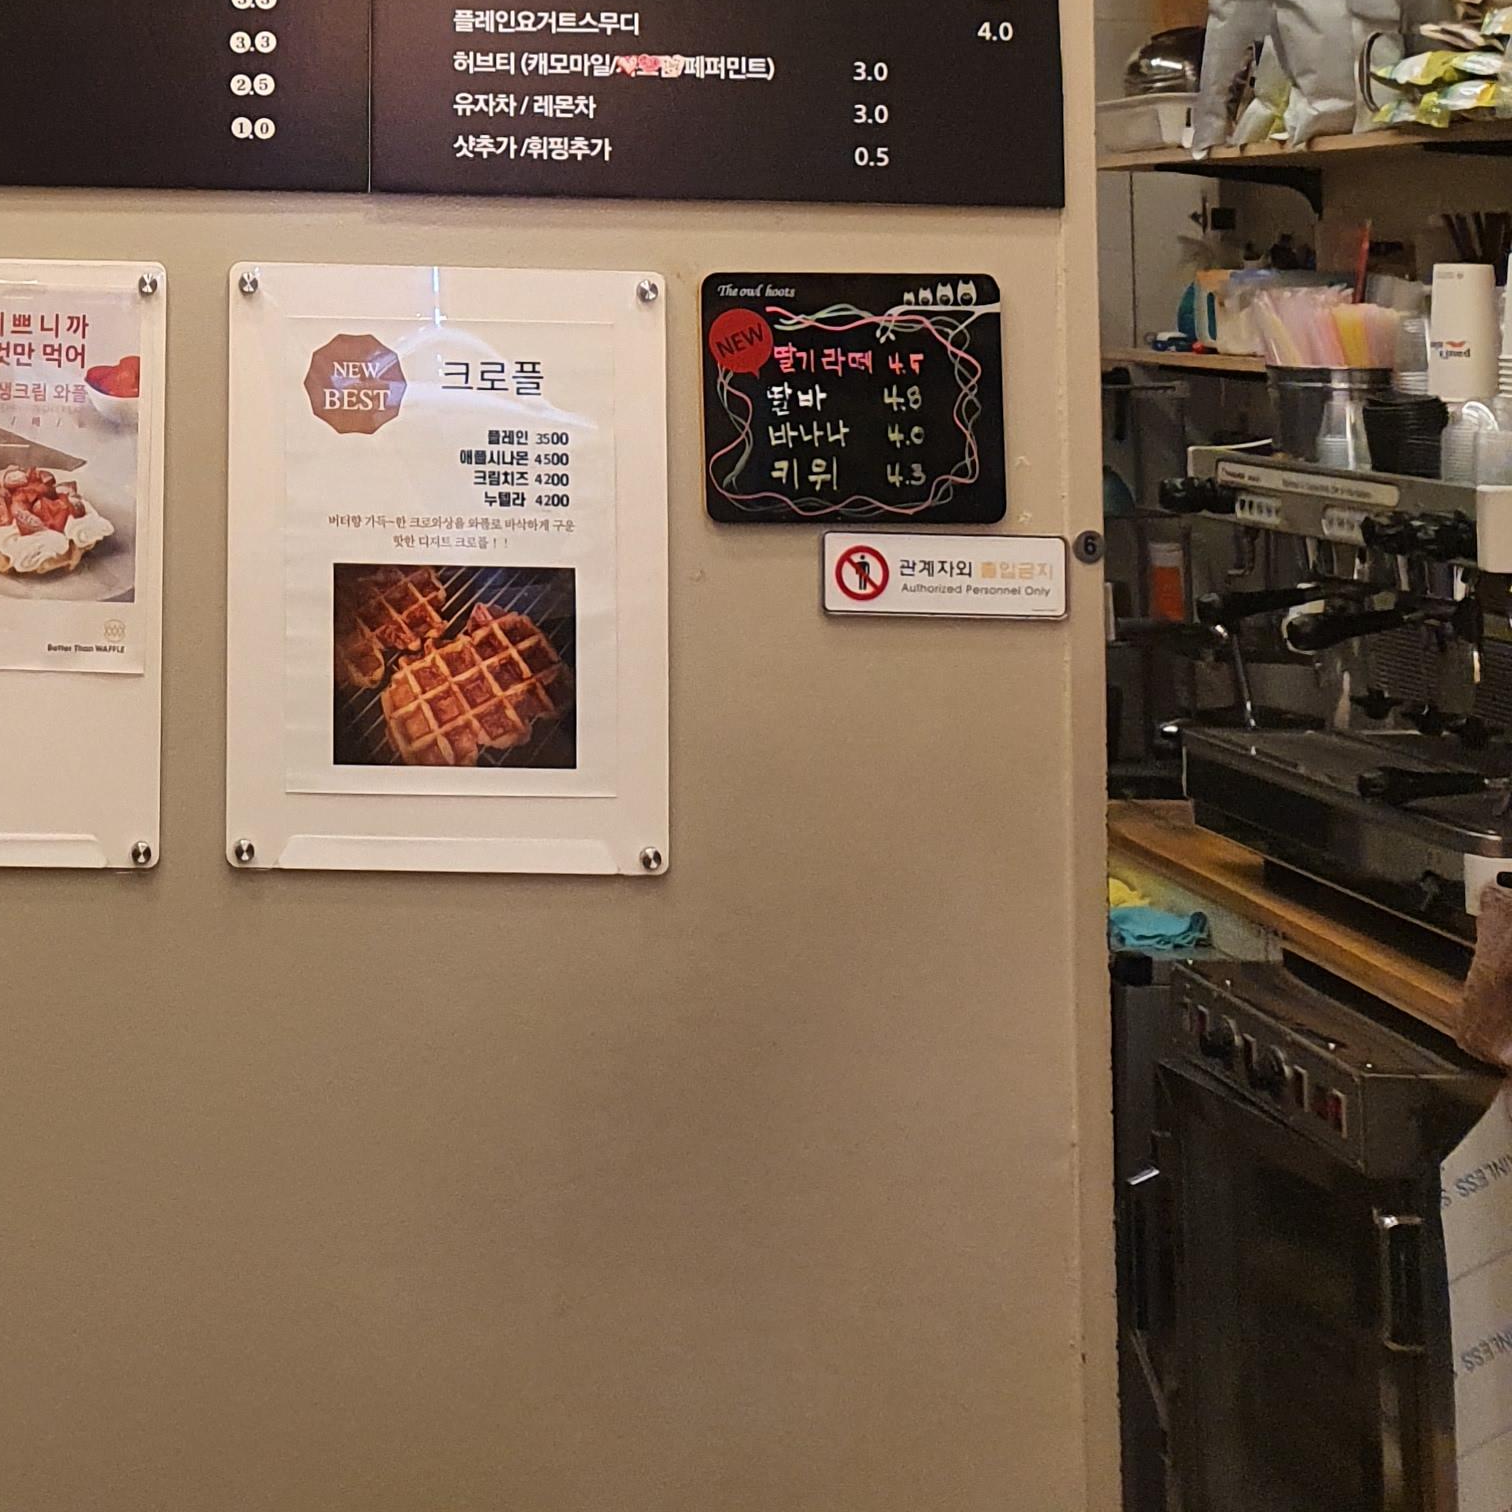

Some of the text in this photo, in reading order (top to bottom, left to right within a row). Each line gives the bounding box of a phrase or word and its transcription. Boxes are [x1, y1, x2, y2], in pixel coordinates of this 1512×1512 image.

[453, 9, 640, 36] 플레인요거트스무디
[977, 21, 1013, 41] 4.0
[453, 51, 515, 75] 허브티
[853, 61, 888, 82] 3.0
[452, 92, 597, 119] 유자차 레몬차
[453, 134, 518, 159] 샷추가
[854, 146, 889, 167] 0.5
[716, 323, 764, 357] NEW
[41, 341, 87, 369] 먹어
[333, 362, 380, 378] NEW
[441, 360, 544, 396] 크로플
[53, 381, 88, 403] 와플
[324, 389, 392, 411] BEST
[487, 430, 569, 446] 플레인 3500
[769, 419, 925, 448] 바나나 4.0
[459, 449, 569, 466] 애플시나몬 4500
[473, 471, 569, 487] 크림치즈 4200
[886, 461, 927, 486] 4.3
[484, 492, 569, 508] 누텔라 4200
[1083, 538, 1097, 554] 6
[900, 559, 972, 577] 관계자외
[901, 583, 1050, 596] Authorized Personnel Only
[95, 645, 125, 653] WAFFLE
